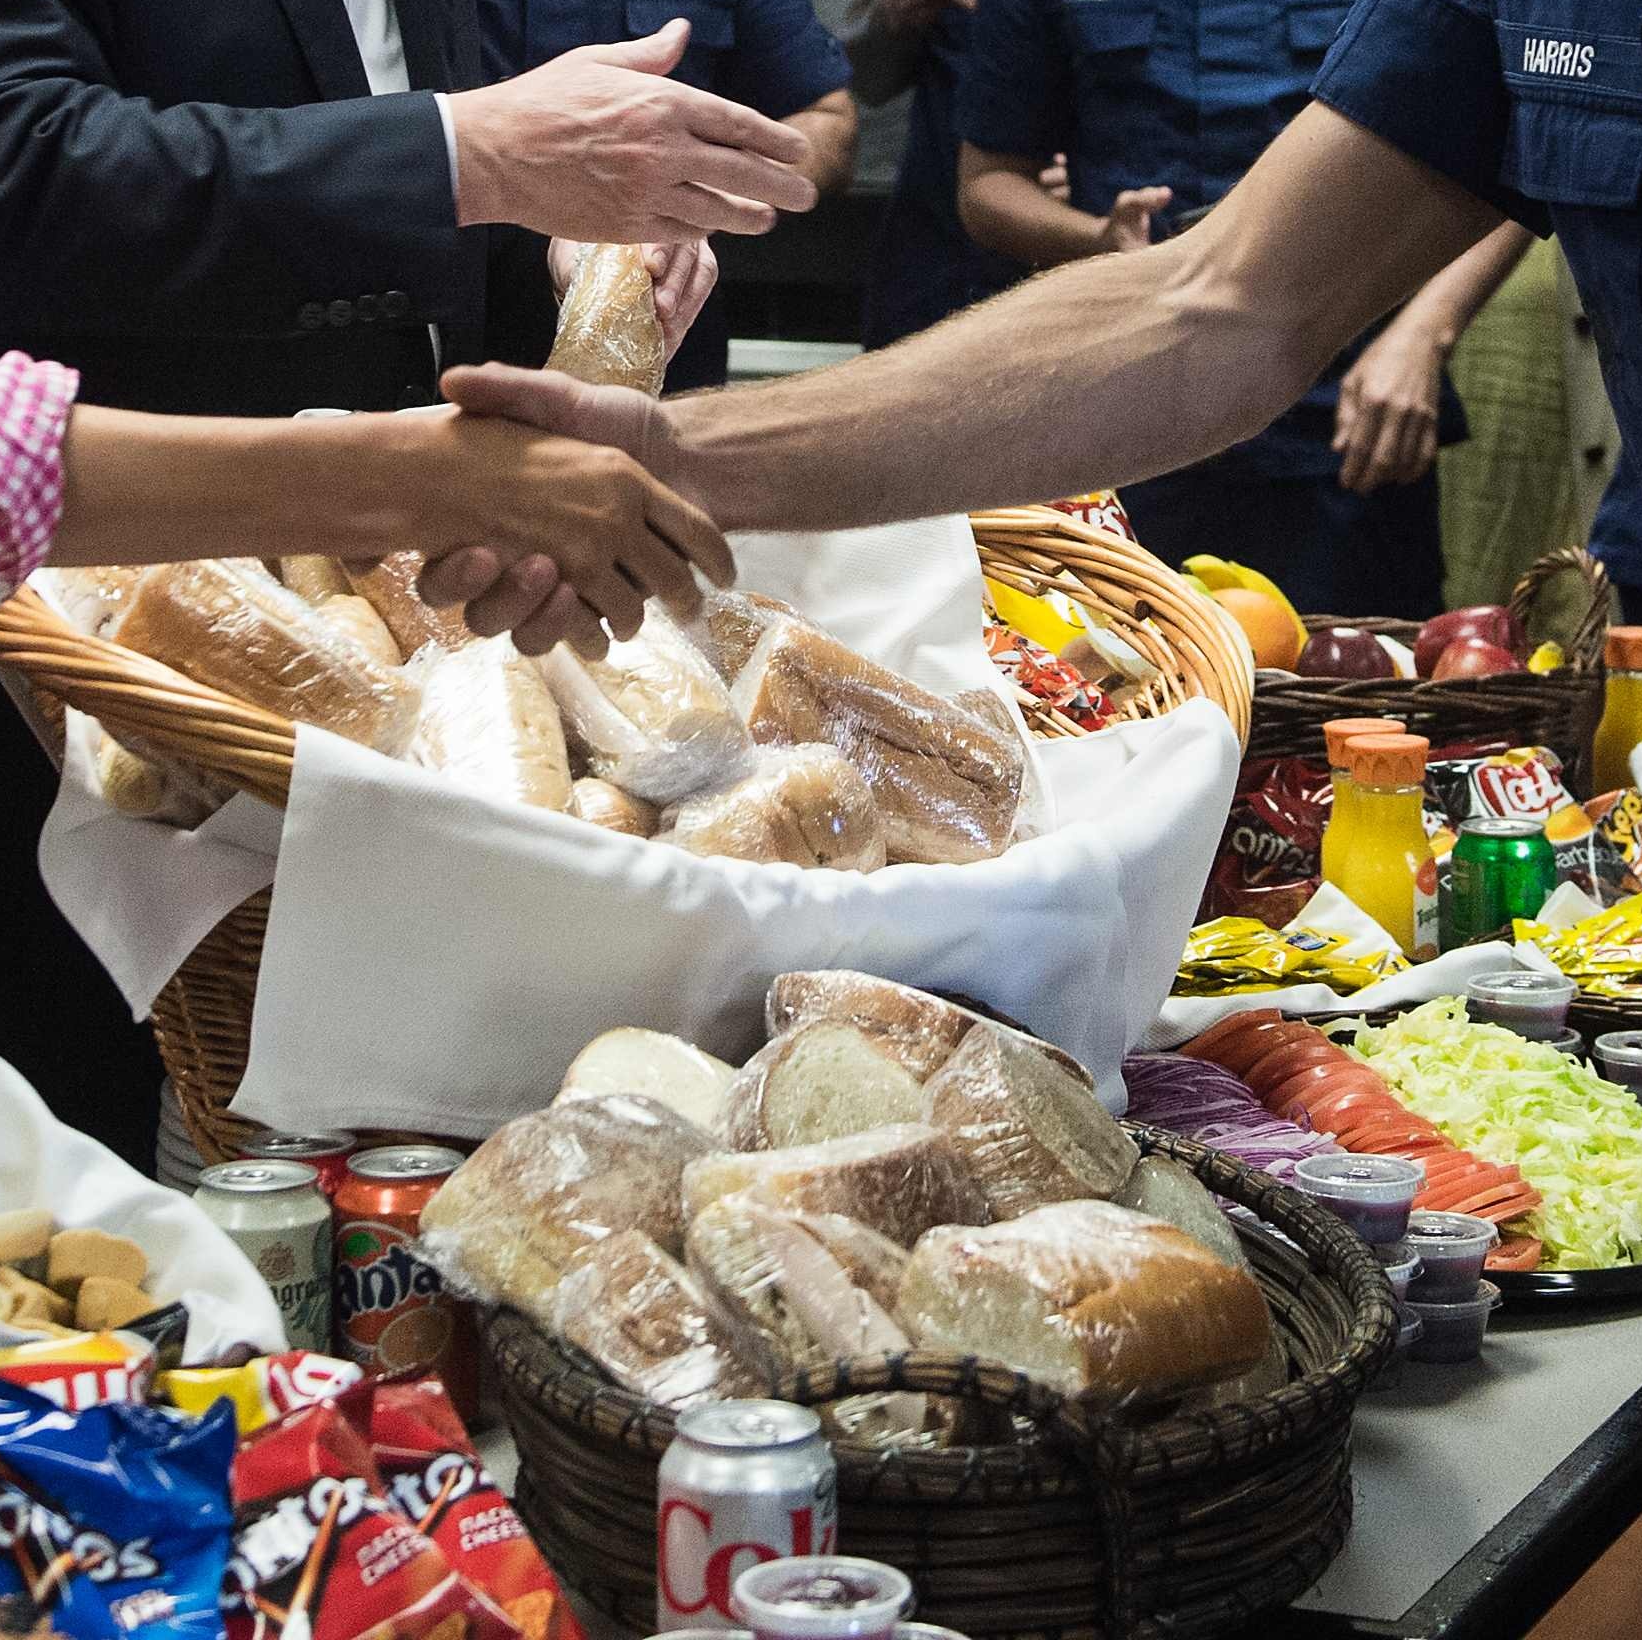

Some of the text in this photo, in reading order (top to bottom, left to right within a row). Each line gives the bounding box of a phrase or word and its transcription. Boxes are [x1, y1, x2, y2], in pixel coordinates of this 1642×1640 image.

[1523, 38, 1595, 78] HARRIS
[1233, 826, 1314, 875] oritos
[339, 1244, 443, 1322] anta
